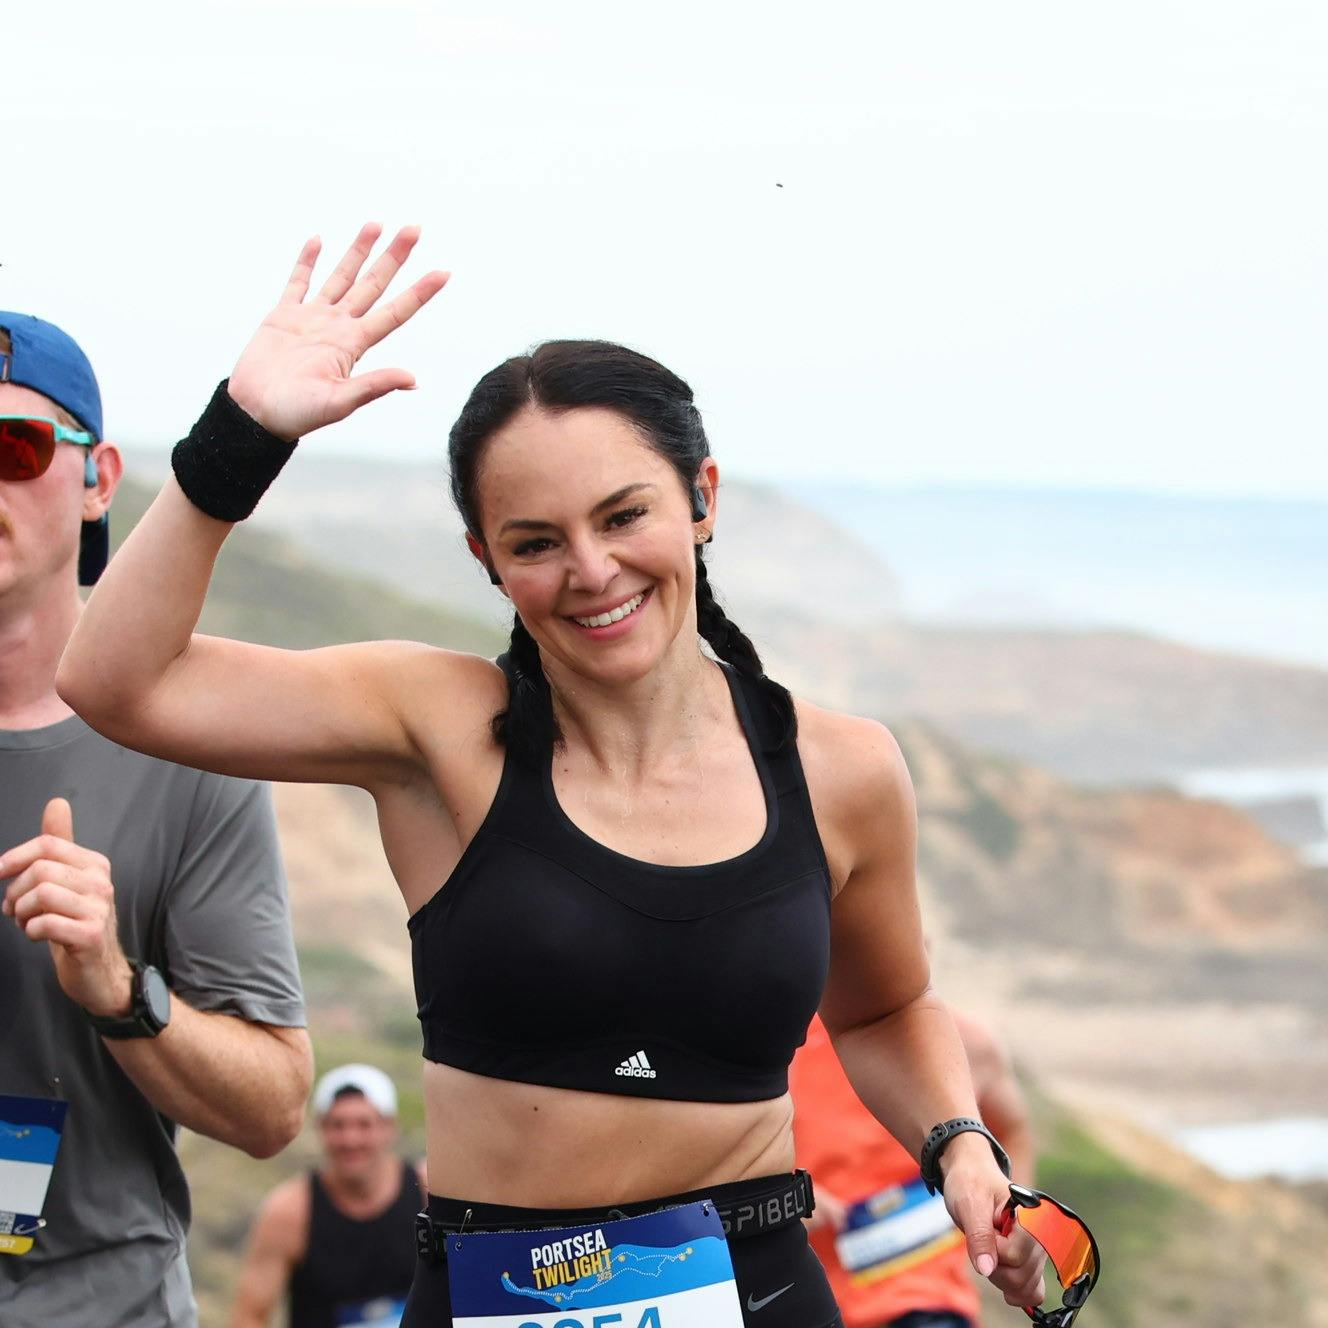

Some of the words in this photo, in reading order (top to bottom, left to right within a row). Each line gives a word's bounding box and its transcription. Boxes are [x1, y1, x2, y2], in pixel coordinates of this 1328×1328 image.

[614, 1066, 657, 1079] adidas
[530, 1228, 608, 1269] PORTSEA
[532, 1248, 613, 1290] TWILIGHT
